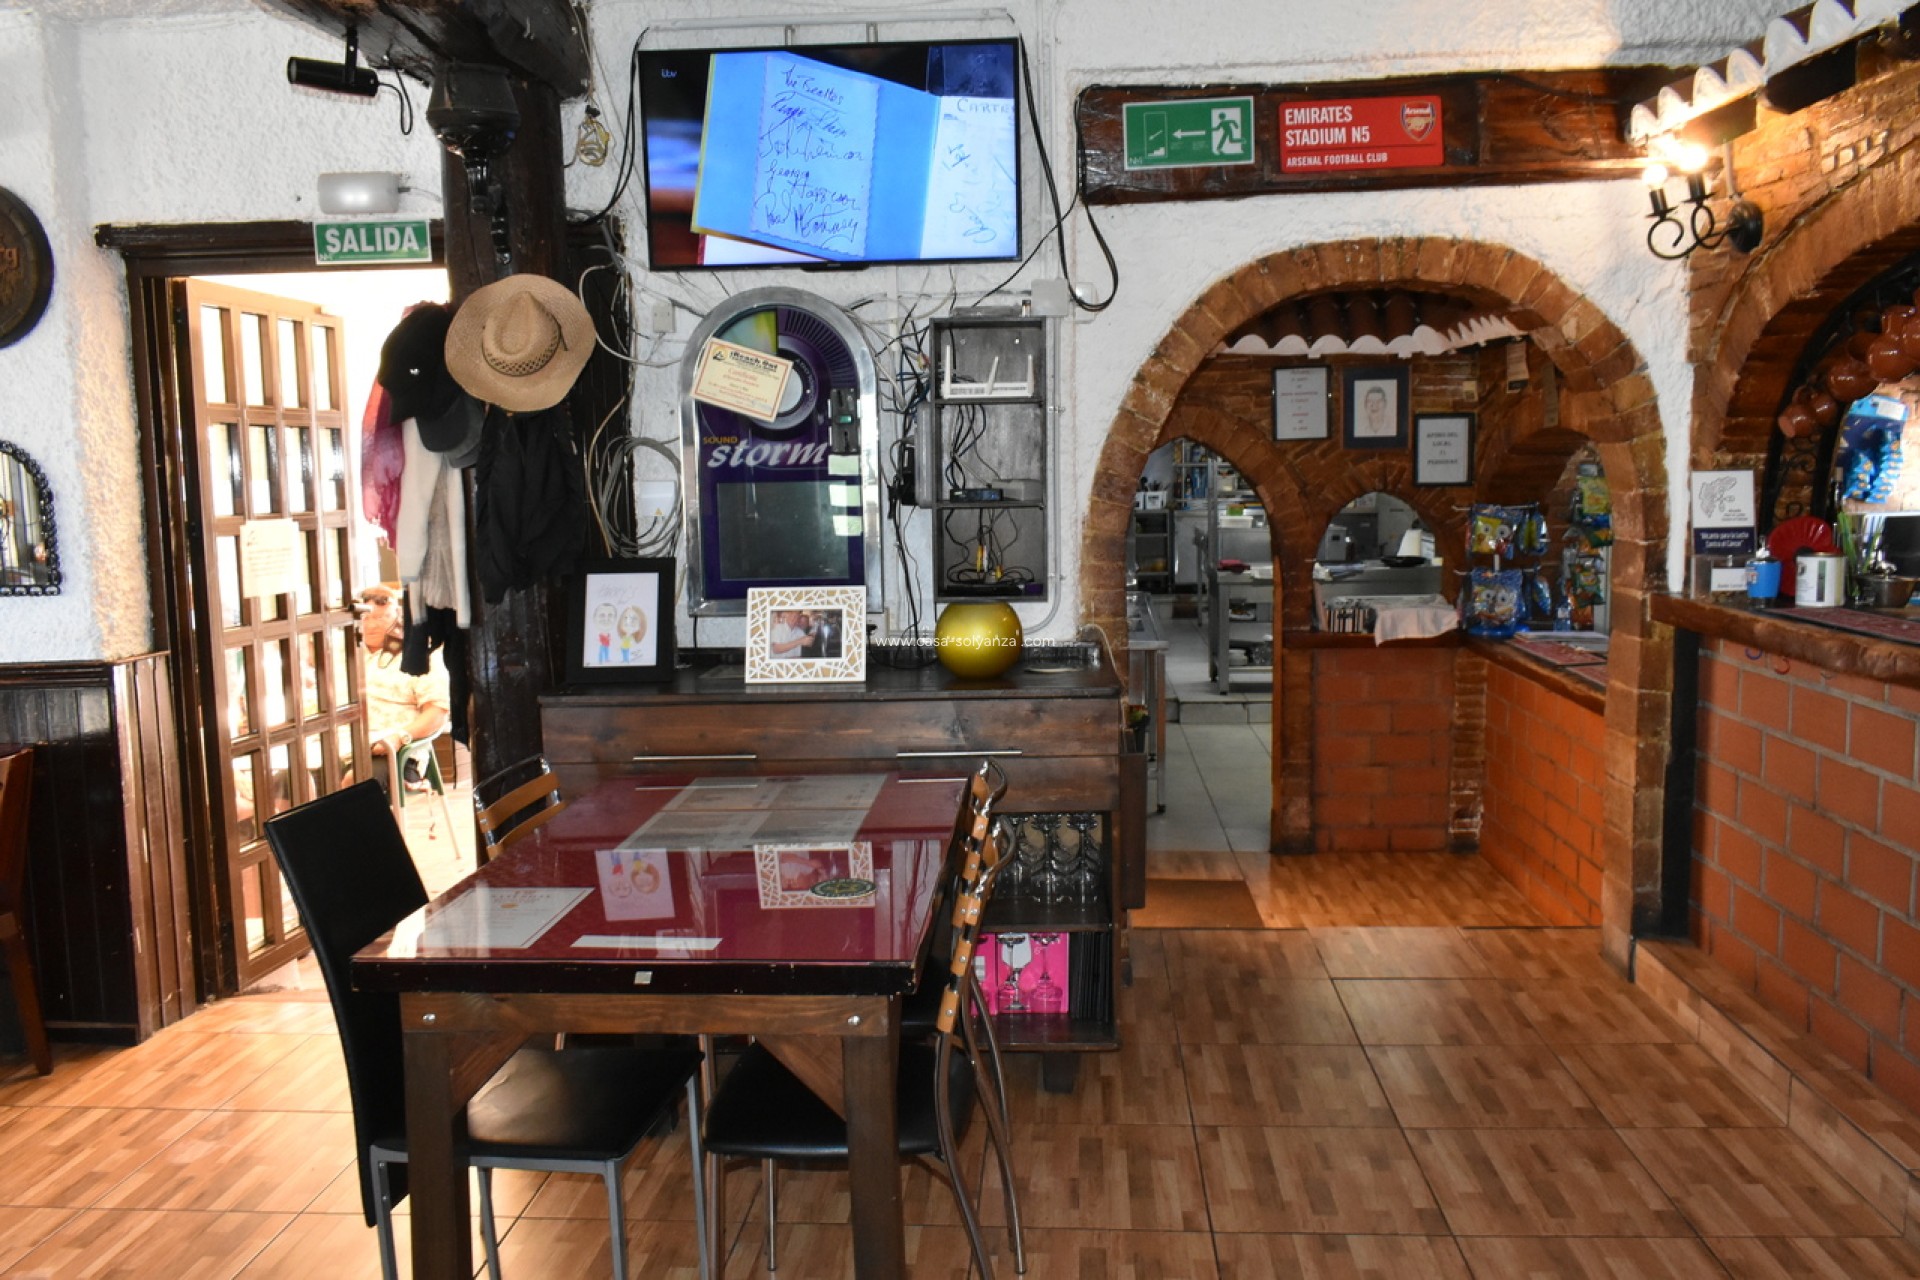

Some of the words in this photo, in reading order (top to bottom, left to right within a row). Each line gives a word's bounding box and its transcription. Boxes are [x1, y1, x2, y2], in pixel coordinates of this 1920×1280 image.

[1285, 105, 1353, 126] EMIRATES
[1285, 127, 1347, 147] STADIUM
[1352, 126, 1371, 144] N5
[1286, 155, 1323, 168] ARSENAL
[1324, 153, 1364, 166] FOOTBALL
[1366, 152, 1388, 164] CLUB
[325, 226, 420, 253] SALIDA
[703, 436, 738, 445] SOUND
[707, 438, 828, 468] storm
